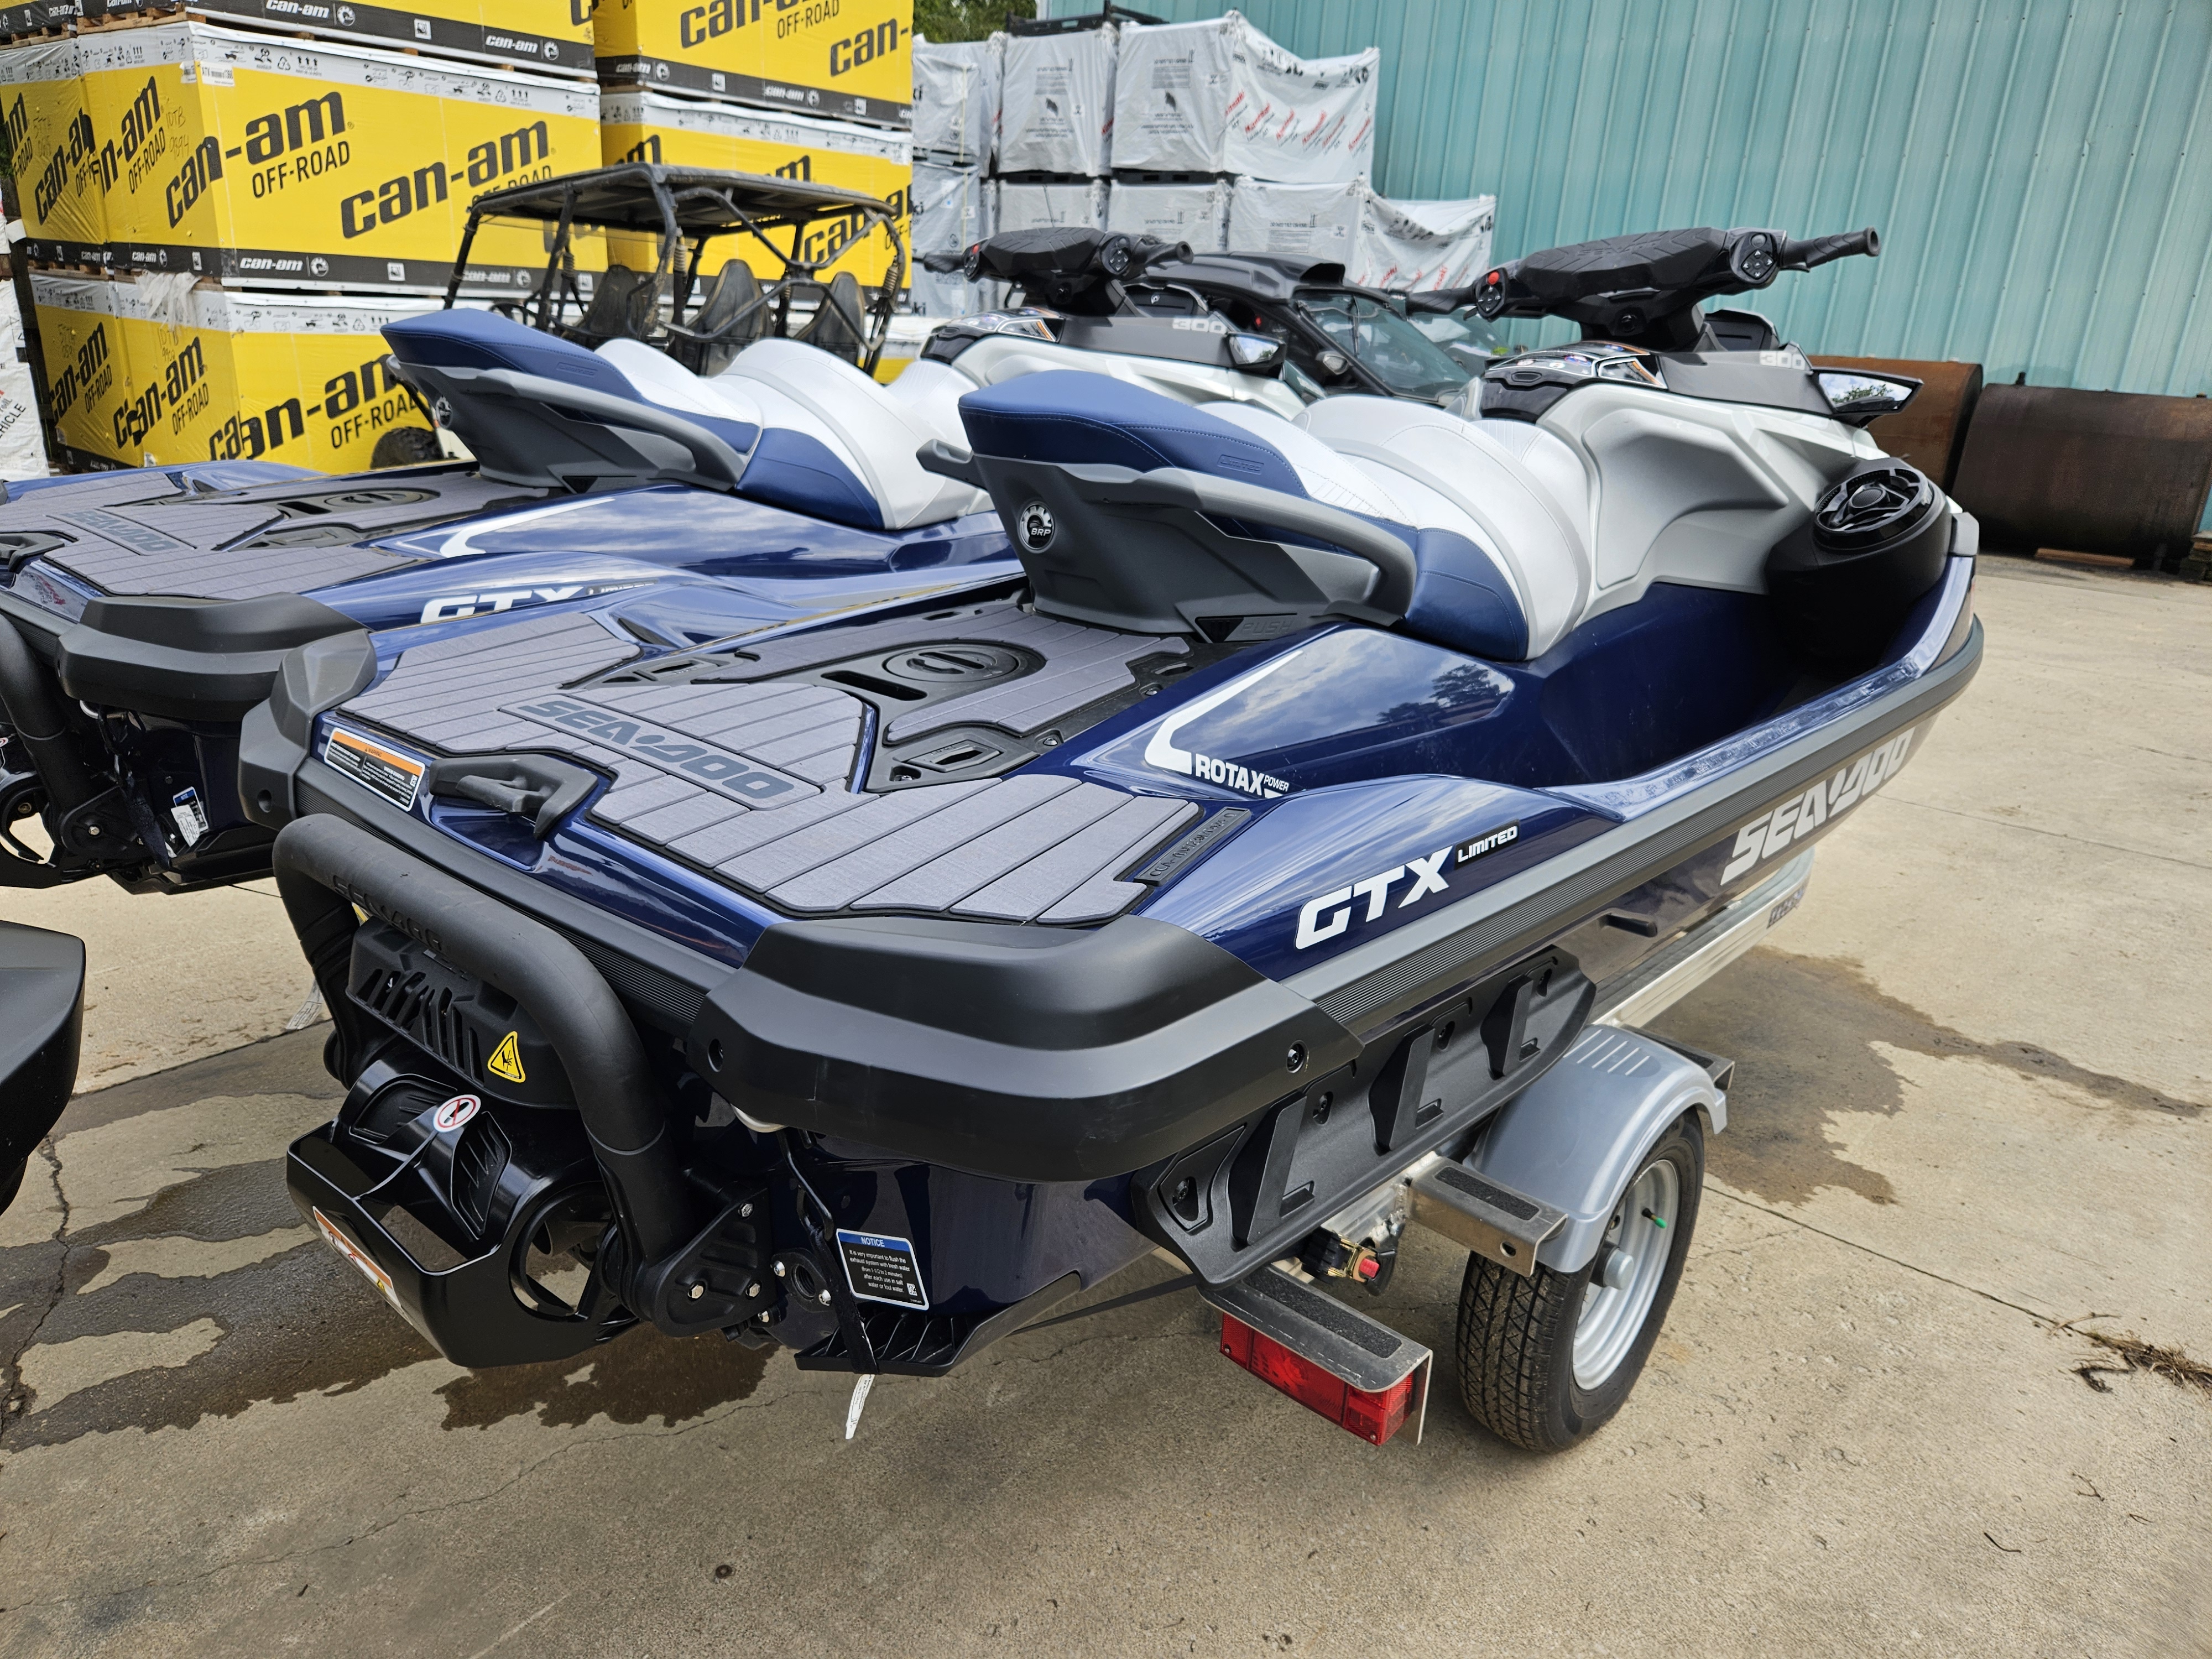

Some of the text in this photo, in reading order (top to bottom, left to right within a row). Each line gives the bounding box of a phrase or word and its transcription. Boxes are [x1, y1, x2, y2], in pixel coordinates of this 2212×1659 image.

[266, 0, 329, 18] can-am
[778, 0, 839, 39] OFF-ROAD
[485, 35, 538, 54] can-am
[128, 127, 165, 194] OFF-ROAD
[166, 91, 345, 228] can-am
[252, 140, 350, 199] OFF-ROAD
[341, 121, 548, 238] can-am
[132, 251, 157, 263] can-am
[240, 257, 302, 272] can-am
[1172, 317, 1227, 334] 300
[1759, 350, 1806, 370] 300
[85, 364, 112, 414] OFF-ROAD
[172, 382, 210, 436] OFF-ROAD
[1031, 528, 1051, 536] BRP
[1241, 621, 1293, 635] PUSH
[1196, 754, 1290, 797] ROTAX POWER
[1295, 846, 1453, 950] GTX
[1458, 825, 1519, 863] LIMITED
[861, 1237, 885, 1247] NOTICE
[866, 1253, 884, 1261] important
